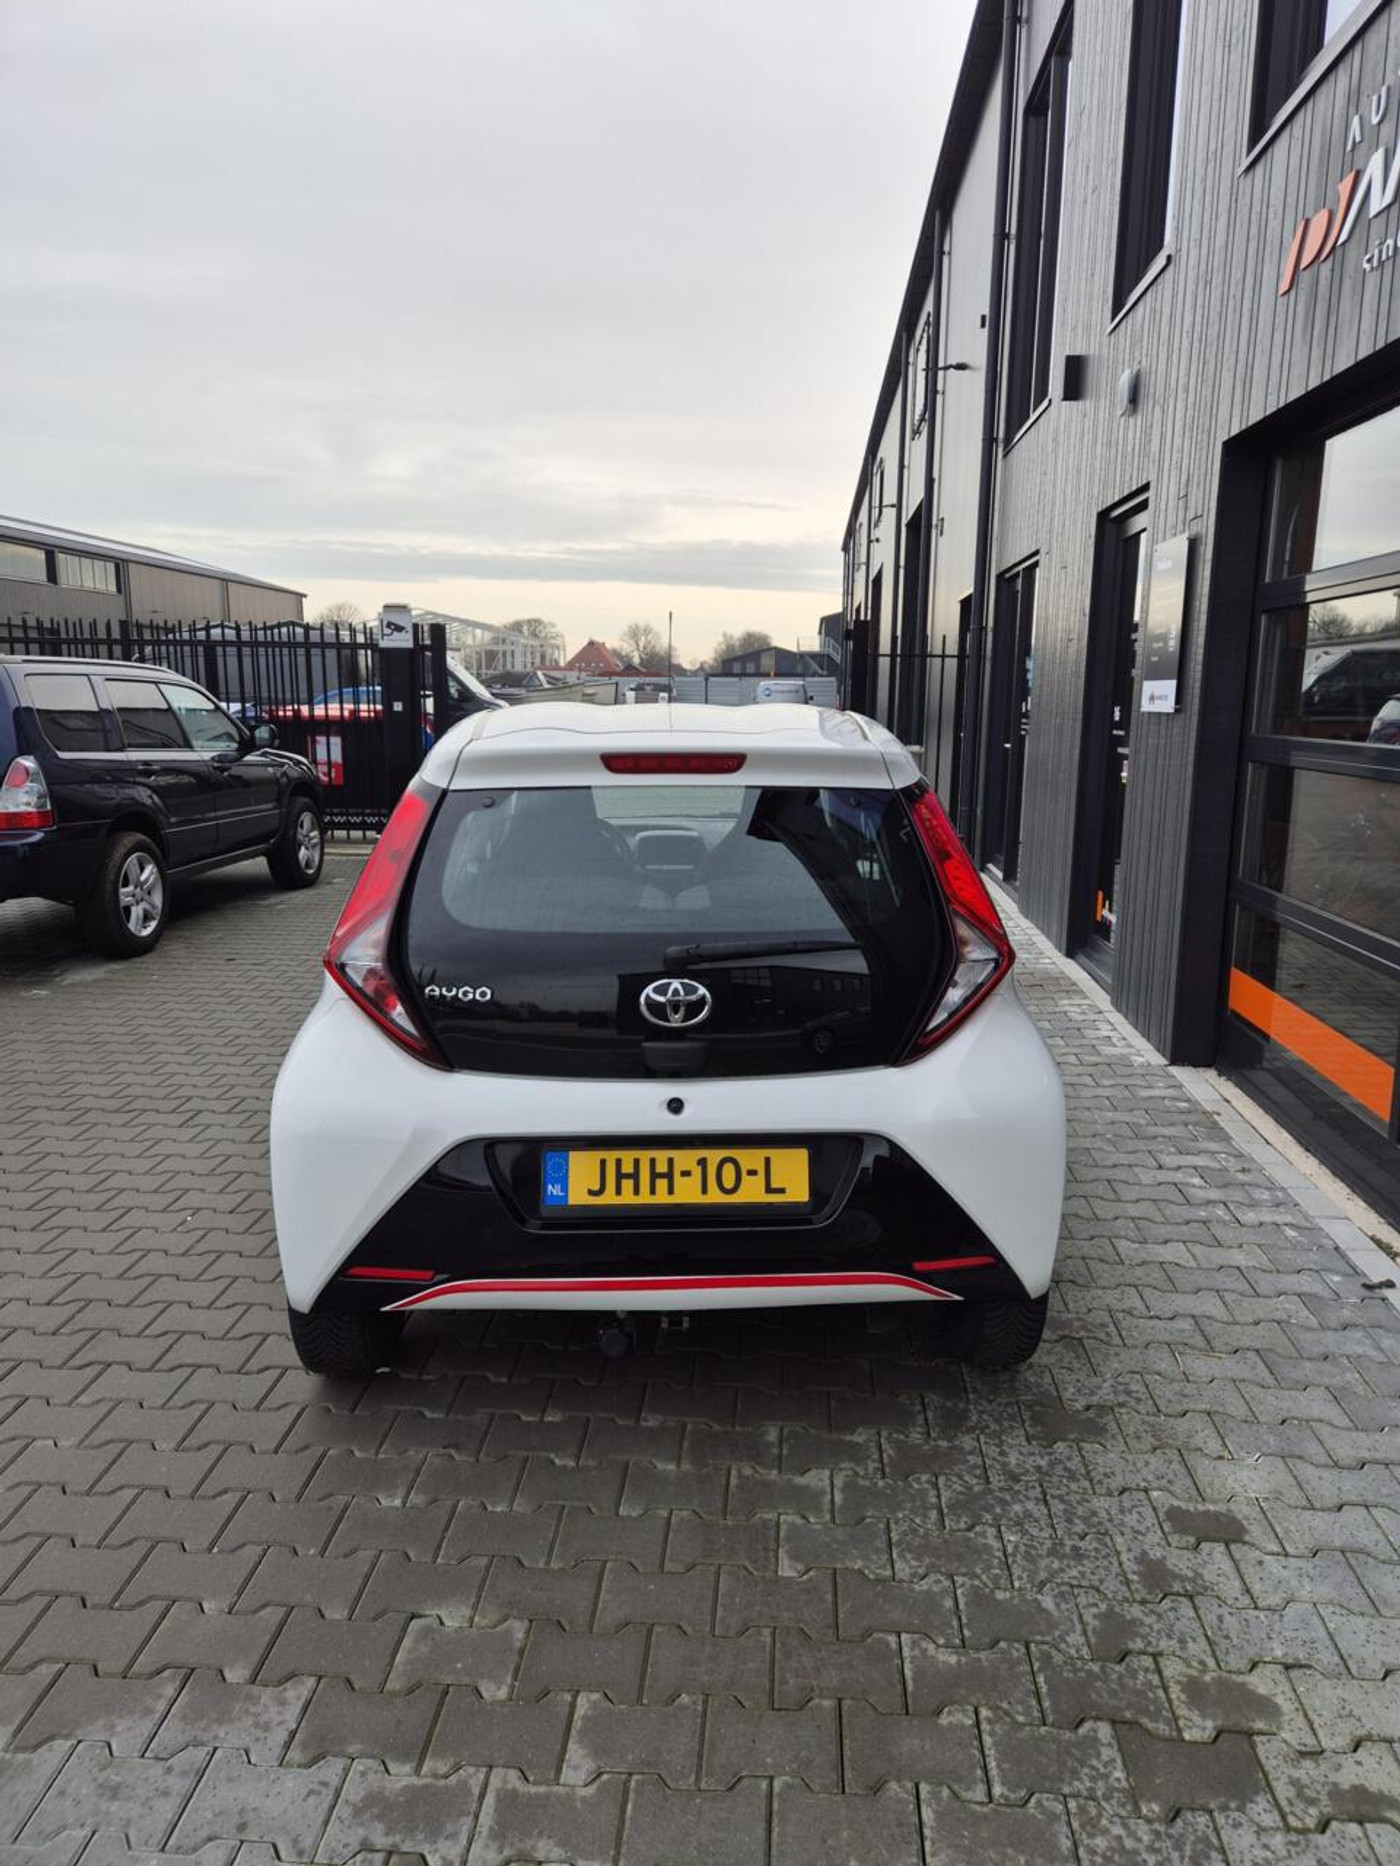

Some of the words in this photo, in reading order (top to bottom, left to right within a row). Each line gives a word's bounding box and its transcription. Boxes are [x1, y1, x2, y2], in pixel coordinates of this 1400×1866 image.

[1347, 69, 1400, 153] AU
[1363, 229, 1400, 272] sin
[424, 984, 492, 1001] AYGO
[548, 1184, 565, 1197] NL
[586, 1155, 787, 1198] JHH-10-L
